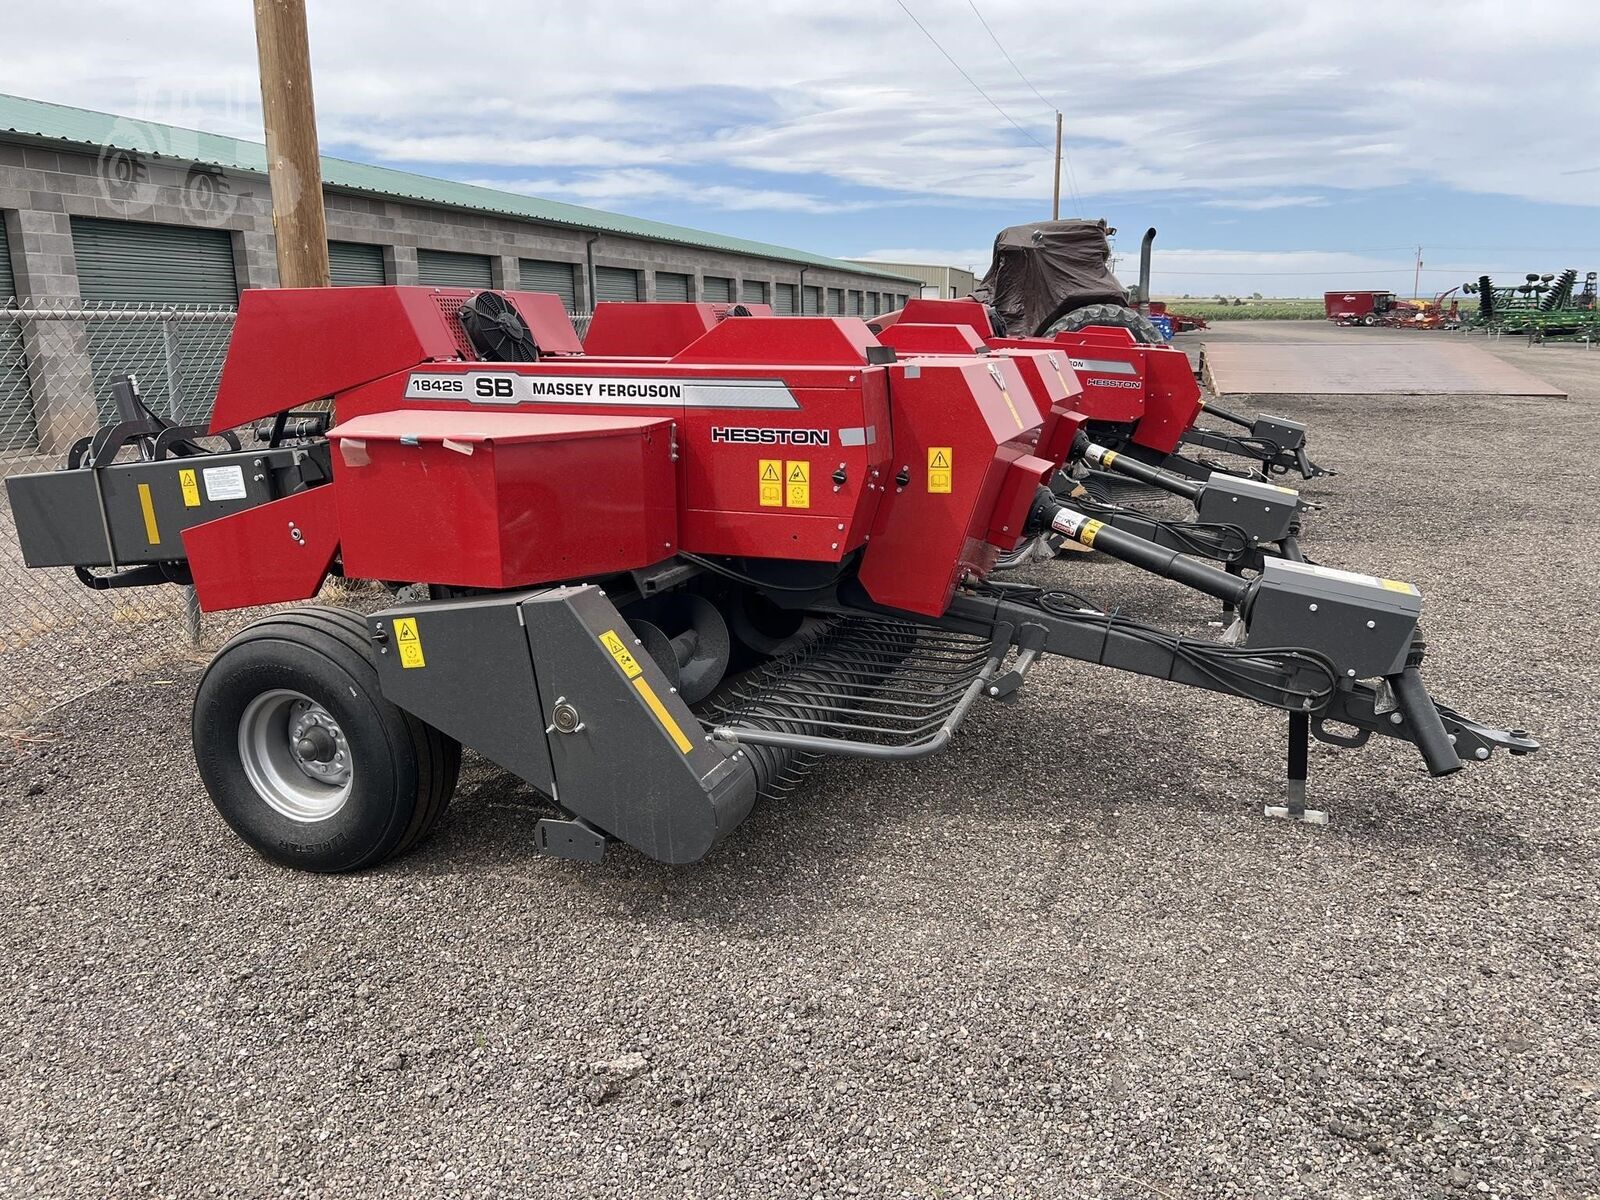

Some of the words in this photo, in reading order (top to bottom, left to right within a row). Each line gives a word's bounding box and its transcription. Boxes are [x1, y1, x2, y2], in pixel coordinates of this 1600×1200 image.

[413, 379, 463, 391] 1842S
[476, 377, 513, 397] SB
[532, 382, 593, 396] MASSEY
[599, 383, 681, 397] FERGUSON
[1088, 378, 1141, 389] HESSTON
[712, 427, 829, 446] HESSTON
